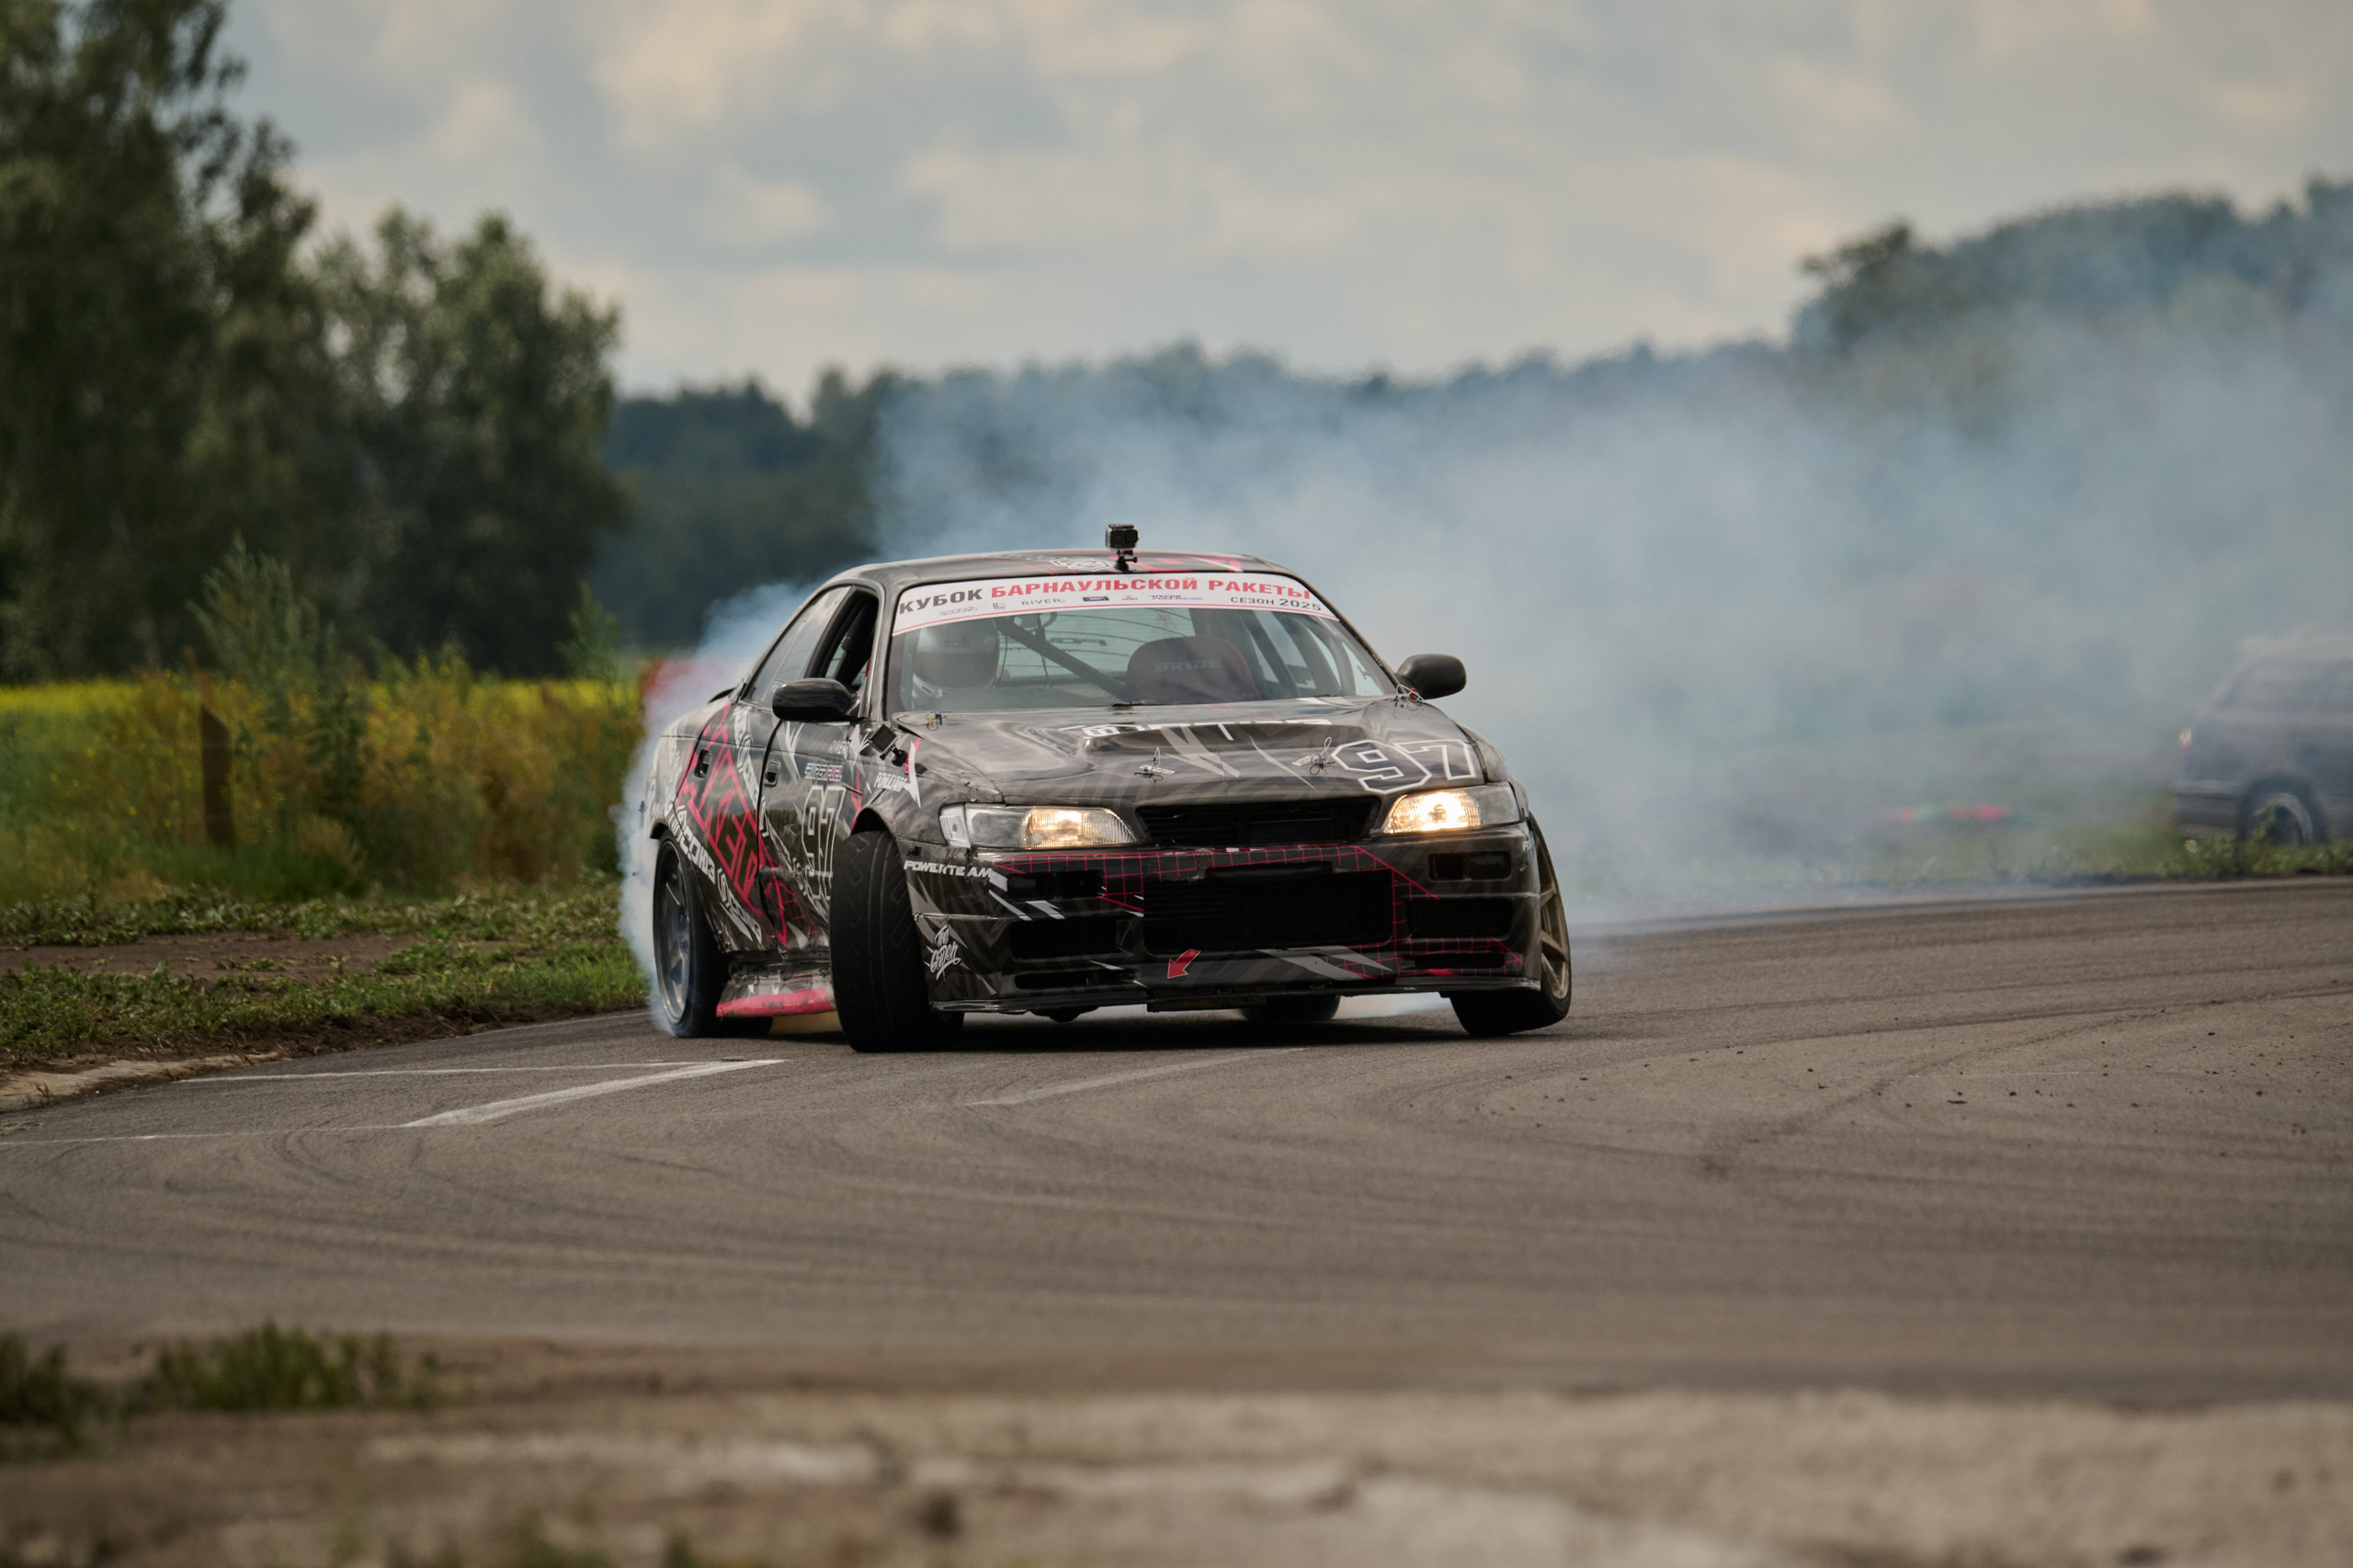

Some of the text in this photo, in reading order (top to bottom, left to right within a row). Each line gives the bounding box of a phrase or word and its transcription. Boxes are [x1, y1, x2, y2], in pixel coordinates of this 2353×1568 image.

[899, 588, 983, 615] КУБОК
[991, 577, 1198, 598] БАРНАУЛЬСКОЙ
[1209, 580, 1312, 599] РАКЕТЫ
[1230, 597, 1322, 611] СЕЗОН 2025
[1154, 659, 1222, 672] BRIDE
[1331, 739, 1476, 794] 97
[802, 784, 847, 901] 97
